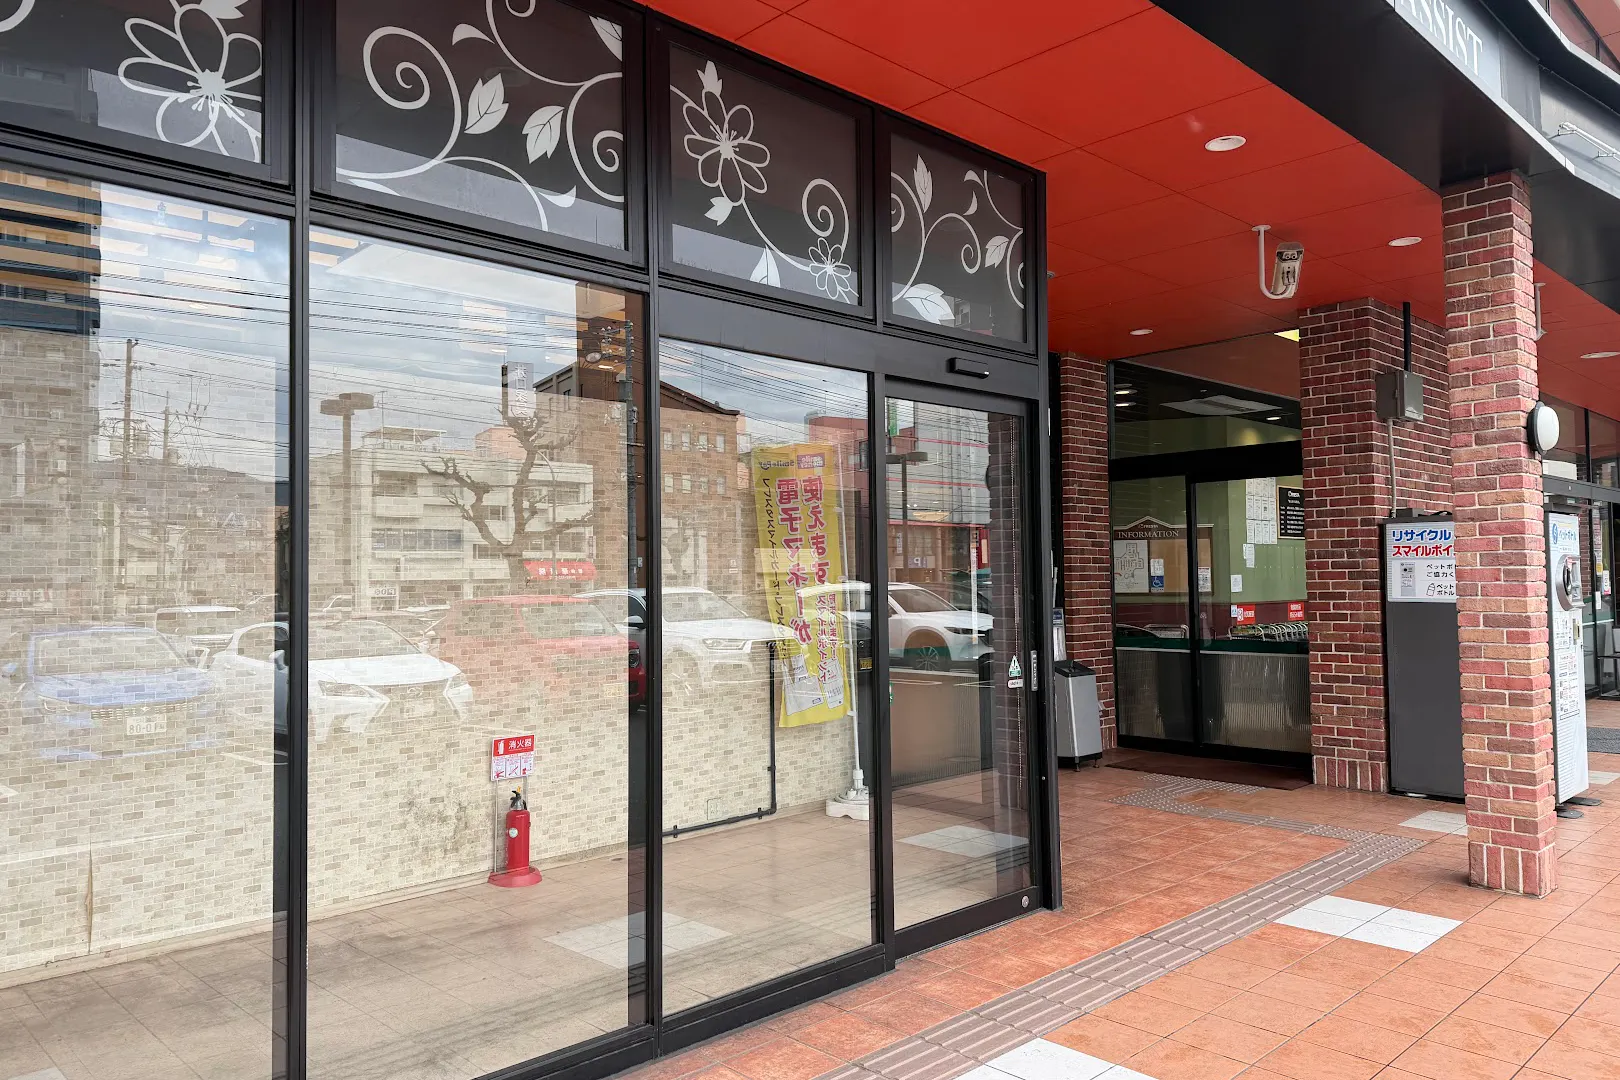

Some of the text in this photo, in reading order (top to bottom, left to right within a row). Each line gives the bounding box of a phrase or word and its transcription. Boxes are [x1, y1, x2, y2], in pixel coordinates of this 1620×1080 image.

[1118, 530, 1179, 539] INFORMATION
[1392, 529, 1452, 542] リサイクル
[1392, 544, 1456, 557] スマイルポイ
[508, 738, 532, 750] 消火器
